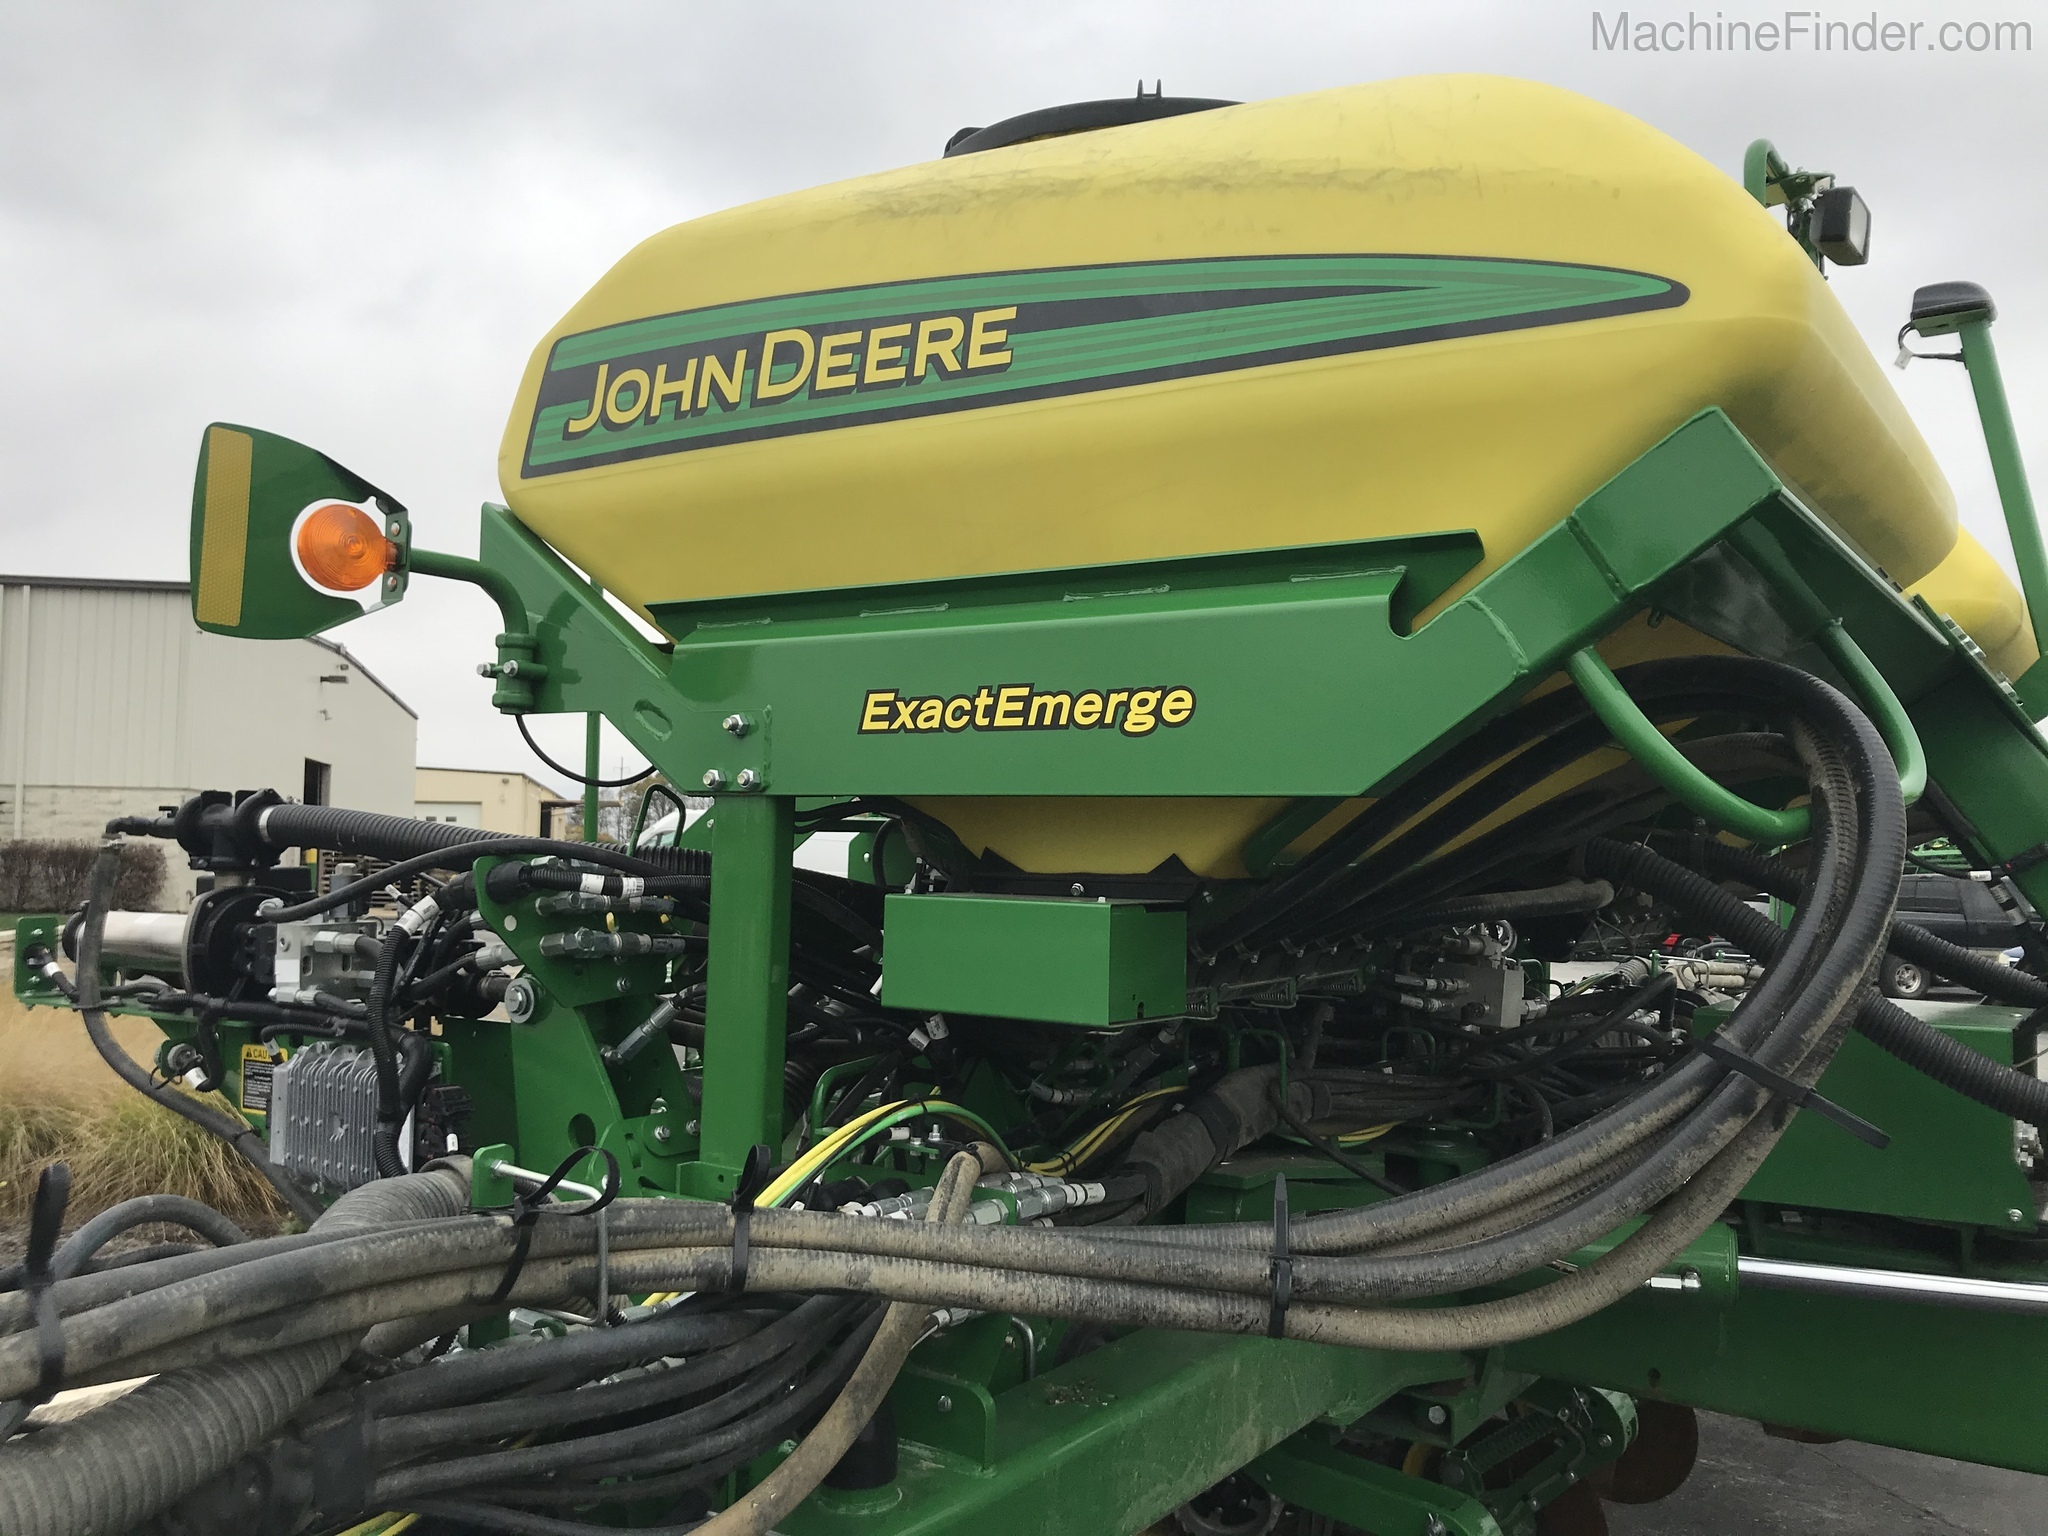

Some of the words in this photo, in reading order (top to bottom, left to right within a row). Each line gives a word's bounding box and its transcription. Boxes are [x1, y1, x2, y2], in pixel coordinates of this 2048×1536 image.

[566, 349, 748, 434] JOHN
[756, 306, 1018, 400] DEERE
[860, 686, 1194, 733] ExactEmerge
